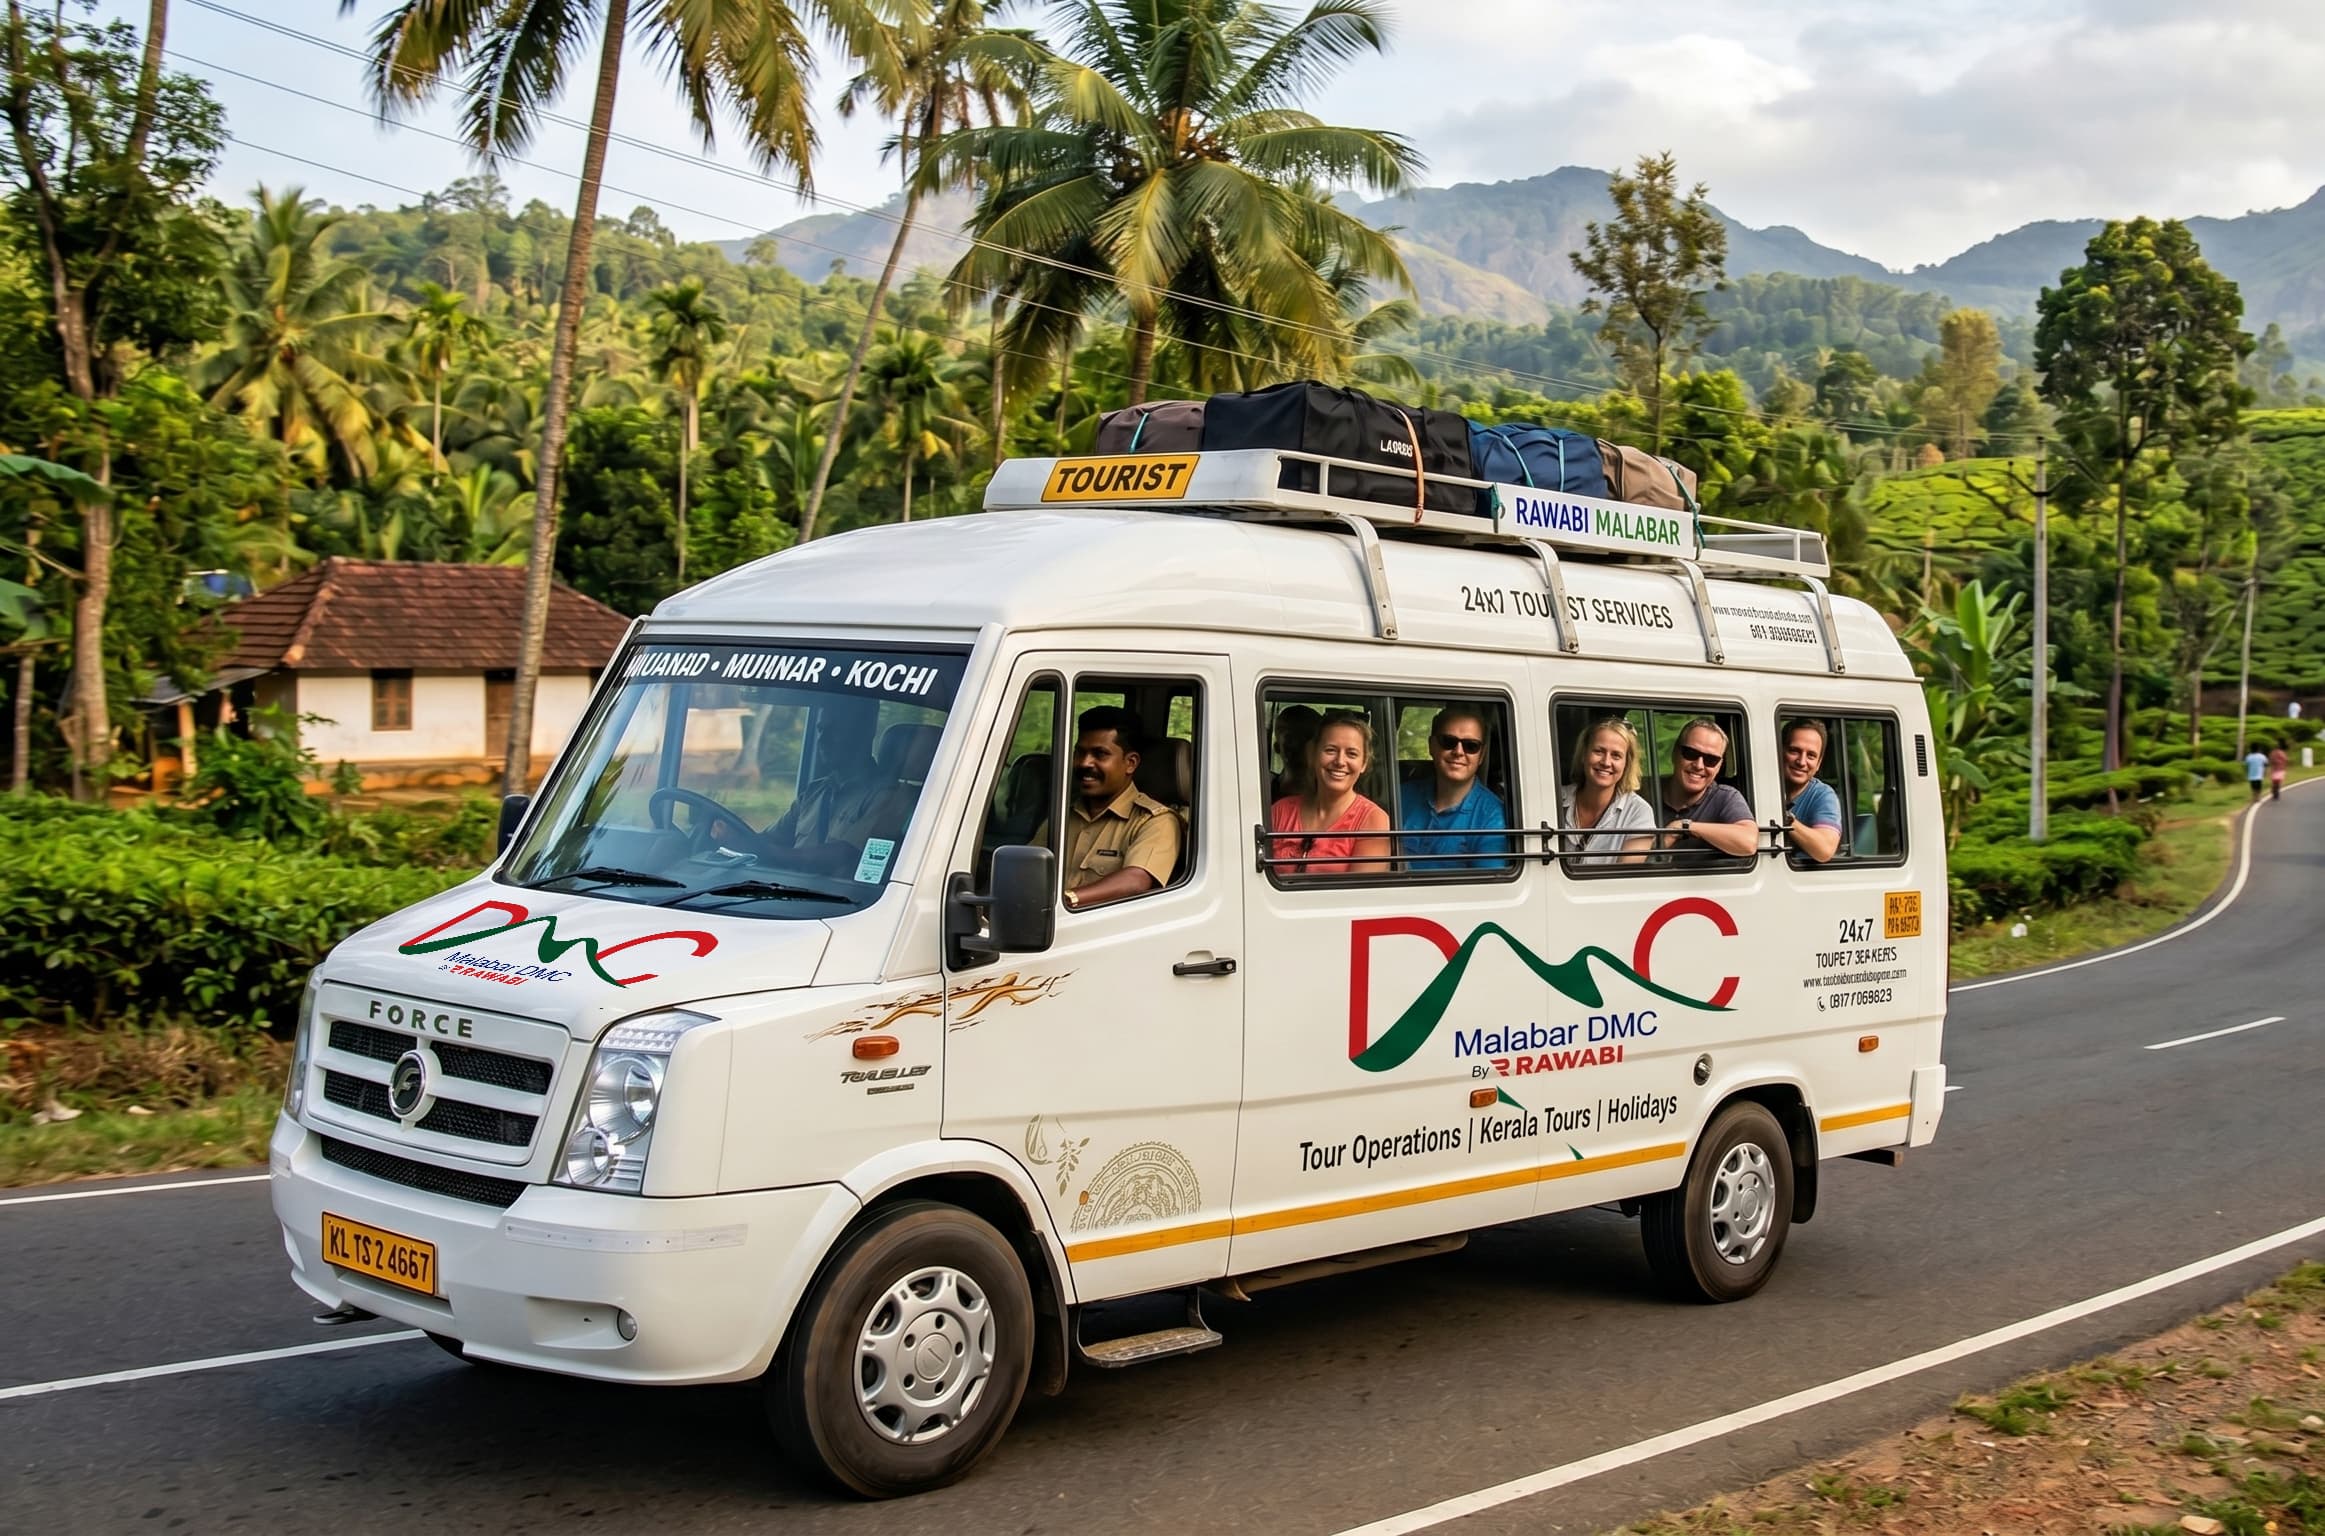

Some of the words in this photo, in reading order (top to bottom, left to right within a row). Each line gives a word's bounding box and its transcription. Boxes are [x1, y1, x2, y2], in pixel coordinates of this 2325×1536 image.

[1056, 463, 1187, 493] TOURIST
[1515, 496, 1589, 534] RAWABI
[1595, 508, 1681, 546] MALABAR
[1509, 590, 1588, 622] TOUST
[1591, 598, 1674, 630] SERVICES
[844, 660, 938, 696] KOCHI
[1839, 918, 1874, 943] 24x7
[514, 965, 572, 982] DMC
[369, 1000, 473, 1039] FORCE
[1454, 1022, 1579, 1058] Malabar
[1588, 1010, 1658, 1042] DMC
[1471, 1065, 1490, 1080] By
[1515, 1045, 1624, 1076] RAWABI
[1299, 1141, 1347, 1172] Tour
[1352, 1125, 1461, 1169] Operations
[1480, 1110, 1538, 1144] Kerala
[1544, 1107, 1591, 1134] Tours
[1607, 1093, 1678, 1124] Holidays
[330, 1225, 350, 1259] KL
[353, 1233, 372, 1266] TS
